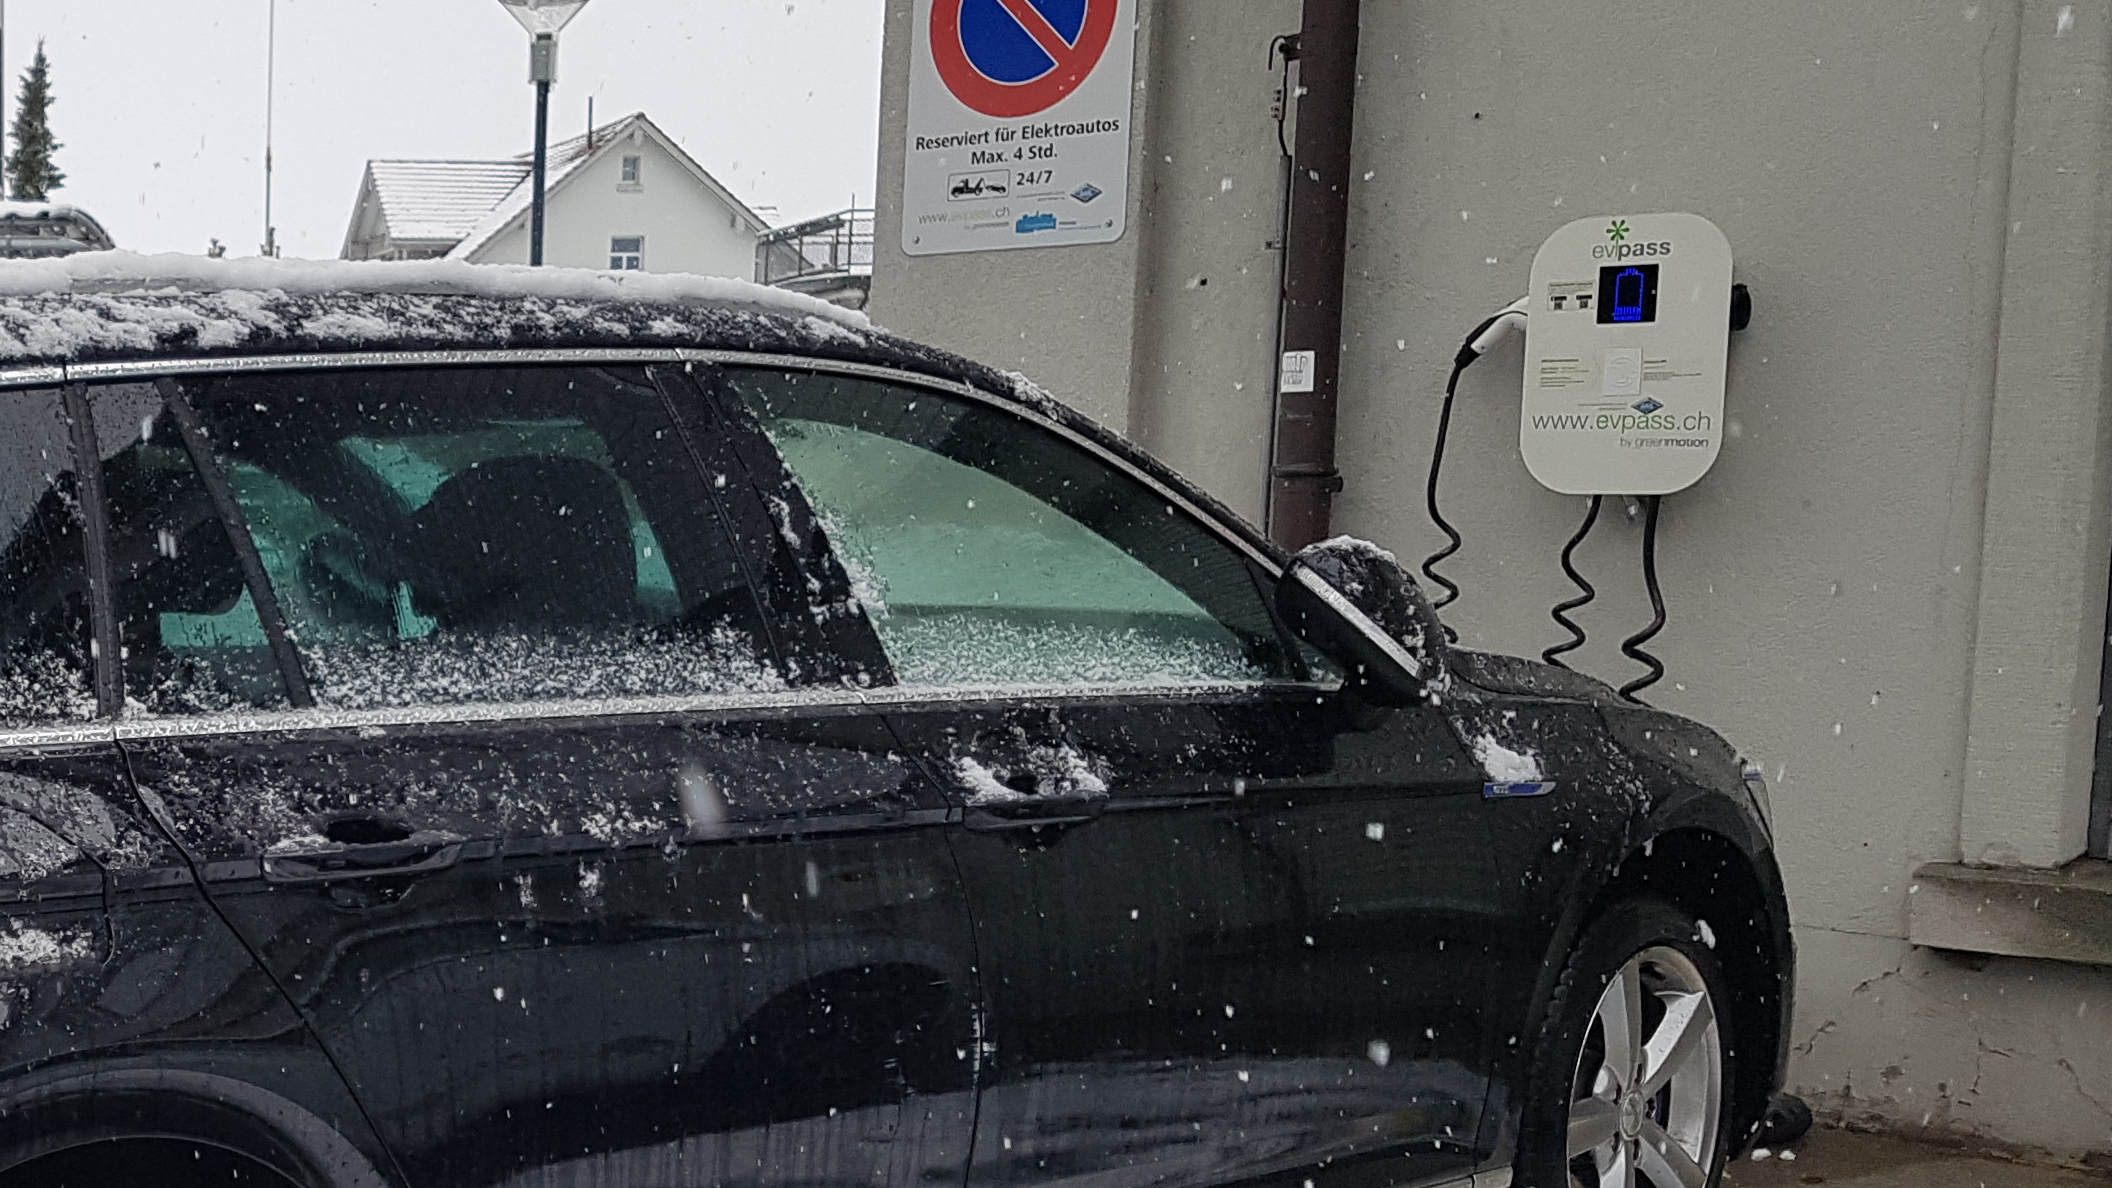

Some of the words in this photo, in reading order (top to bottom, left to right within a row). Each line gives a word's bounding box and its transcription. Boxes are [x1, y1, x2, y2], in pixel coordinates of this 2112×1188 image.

[915, 131, 990, 151] Reserviert
[994, 127, 1017, 143] für
[1021, 119, 1120, 140] Elektroautos
[971, 150, 1008, 165] Max.
[1013, 147, 1023, 160] 4
[1028, 143, 1058, 160] Std.
[1016, 170, 1053, 186] 24/7
[918, 206, 1011, 225] www..ch
[1532, 411, 1711, 434] www.evpass.ch
